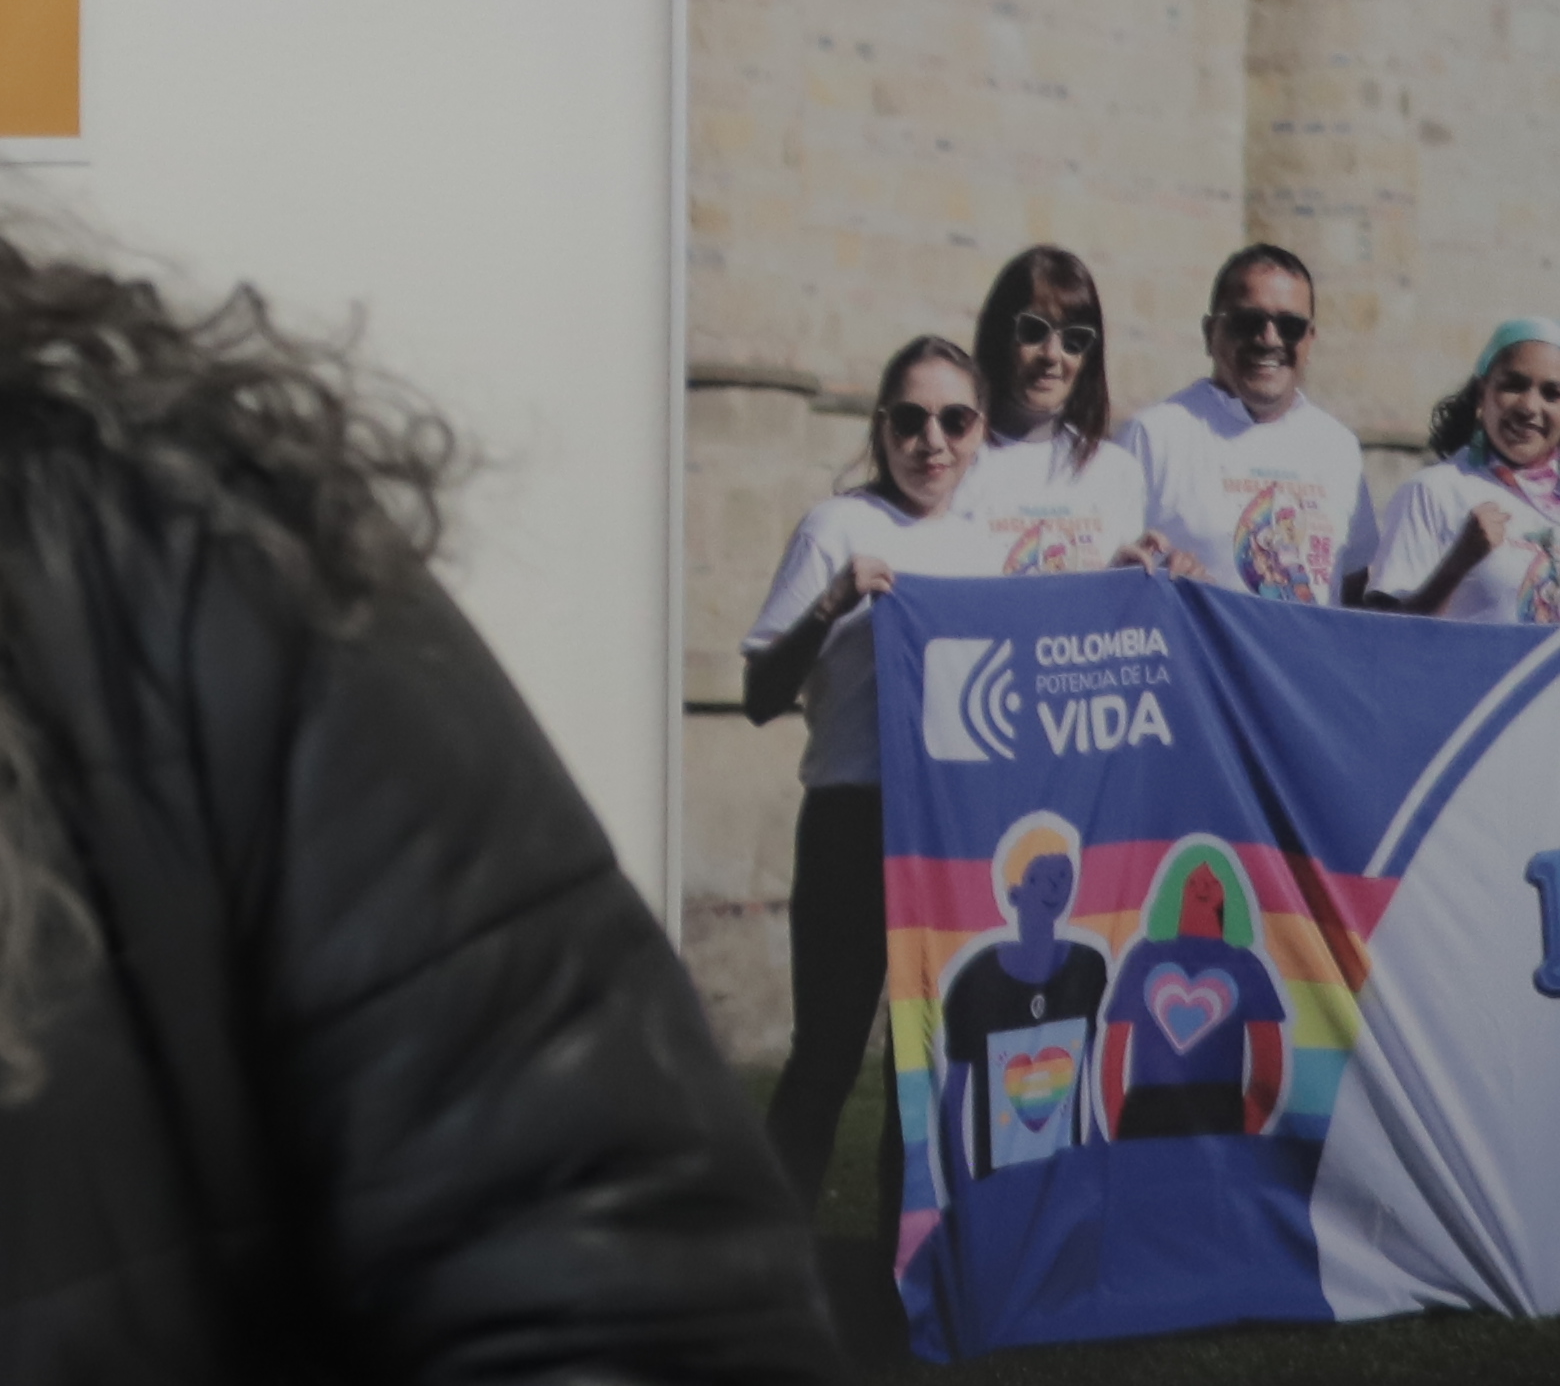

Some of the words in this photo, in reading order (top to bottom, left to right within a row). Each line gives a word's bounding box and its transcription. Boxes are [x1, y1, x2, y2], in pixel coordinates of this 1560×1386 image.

[1034, 626, 1170, 668] COLOMBIA
[1035, 668, 1118, 695] POTENCIA
[1121, 664, 1141, 686] DE
[1145, 663, 1171, 685] LA
[1036, 689, 1174, 757] VIDA
